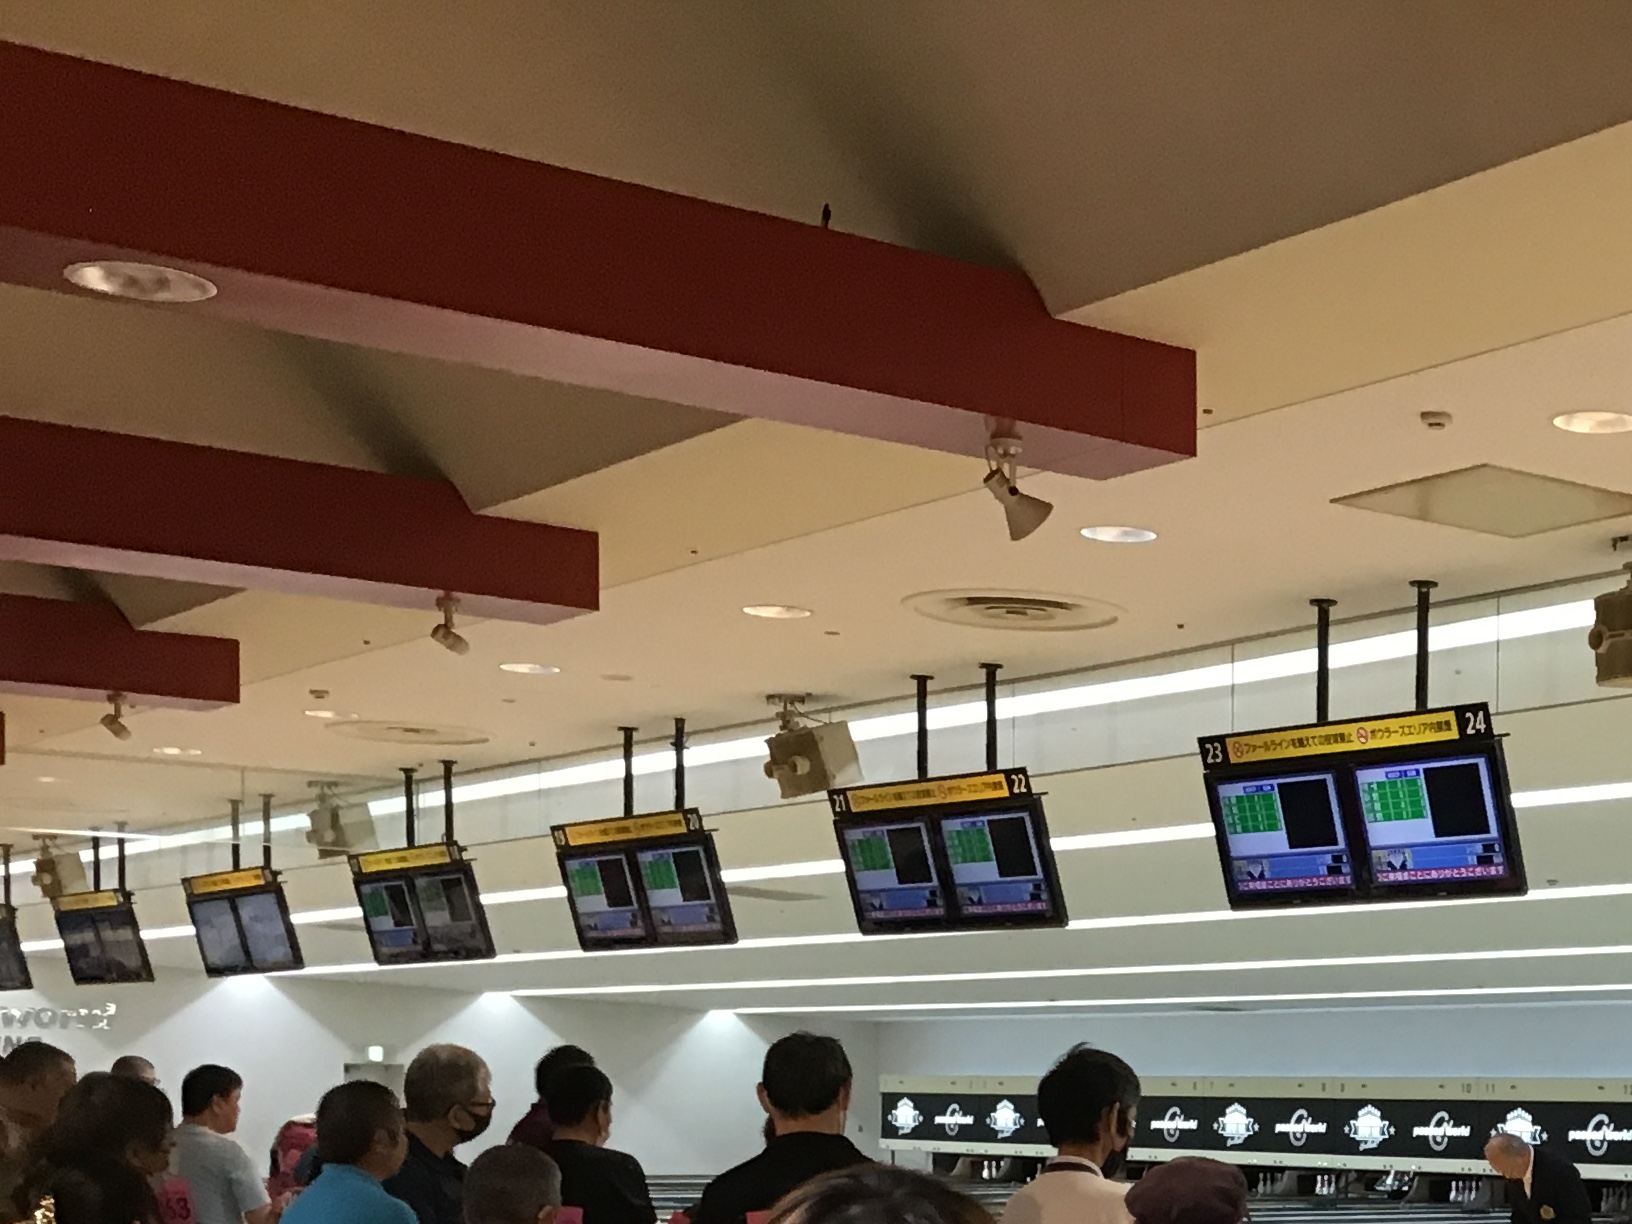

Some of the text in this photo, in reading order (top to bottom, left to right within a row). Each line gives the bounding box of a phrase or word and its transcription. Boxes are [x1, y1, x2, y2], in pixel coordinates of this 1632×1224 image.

[1465, 711, 1486, 734] 24
[1204, 743, 1223, 763] 23
[1011, 774, 1027, 793] 22
[833, 794, 847, 812] 21
